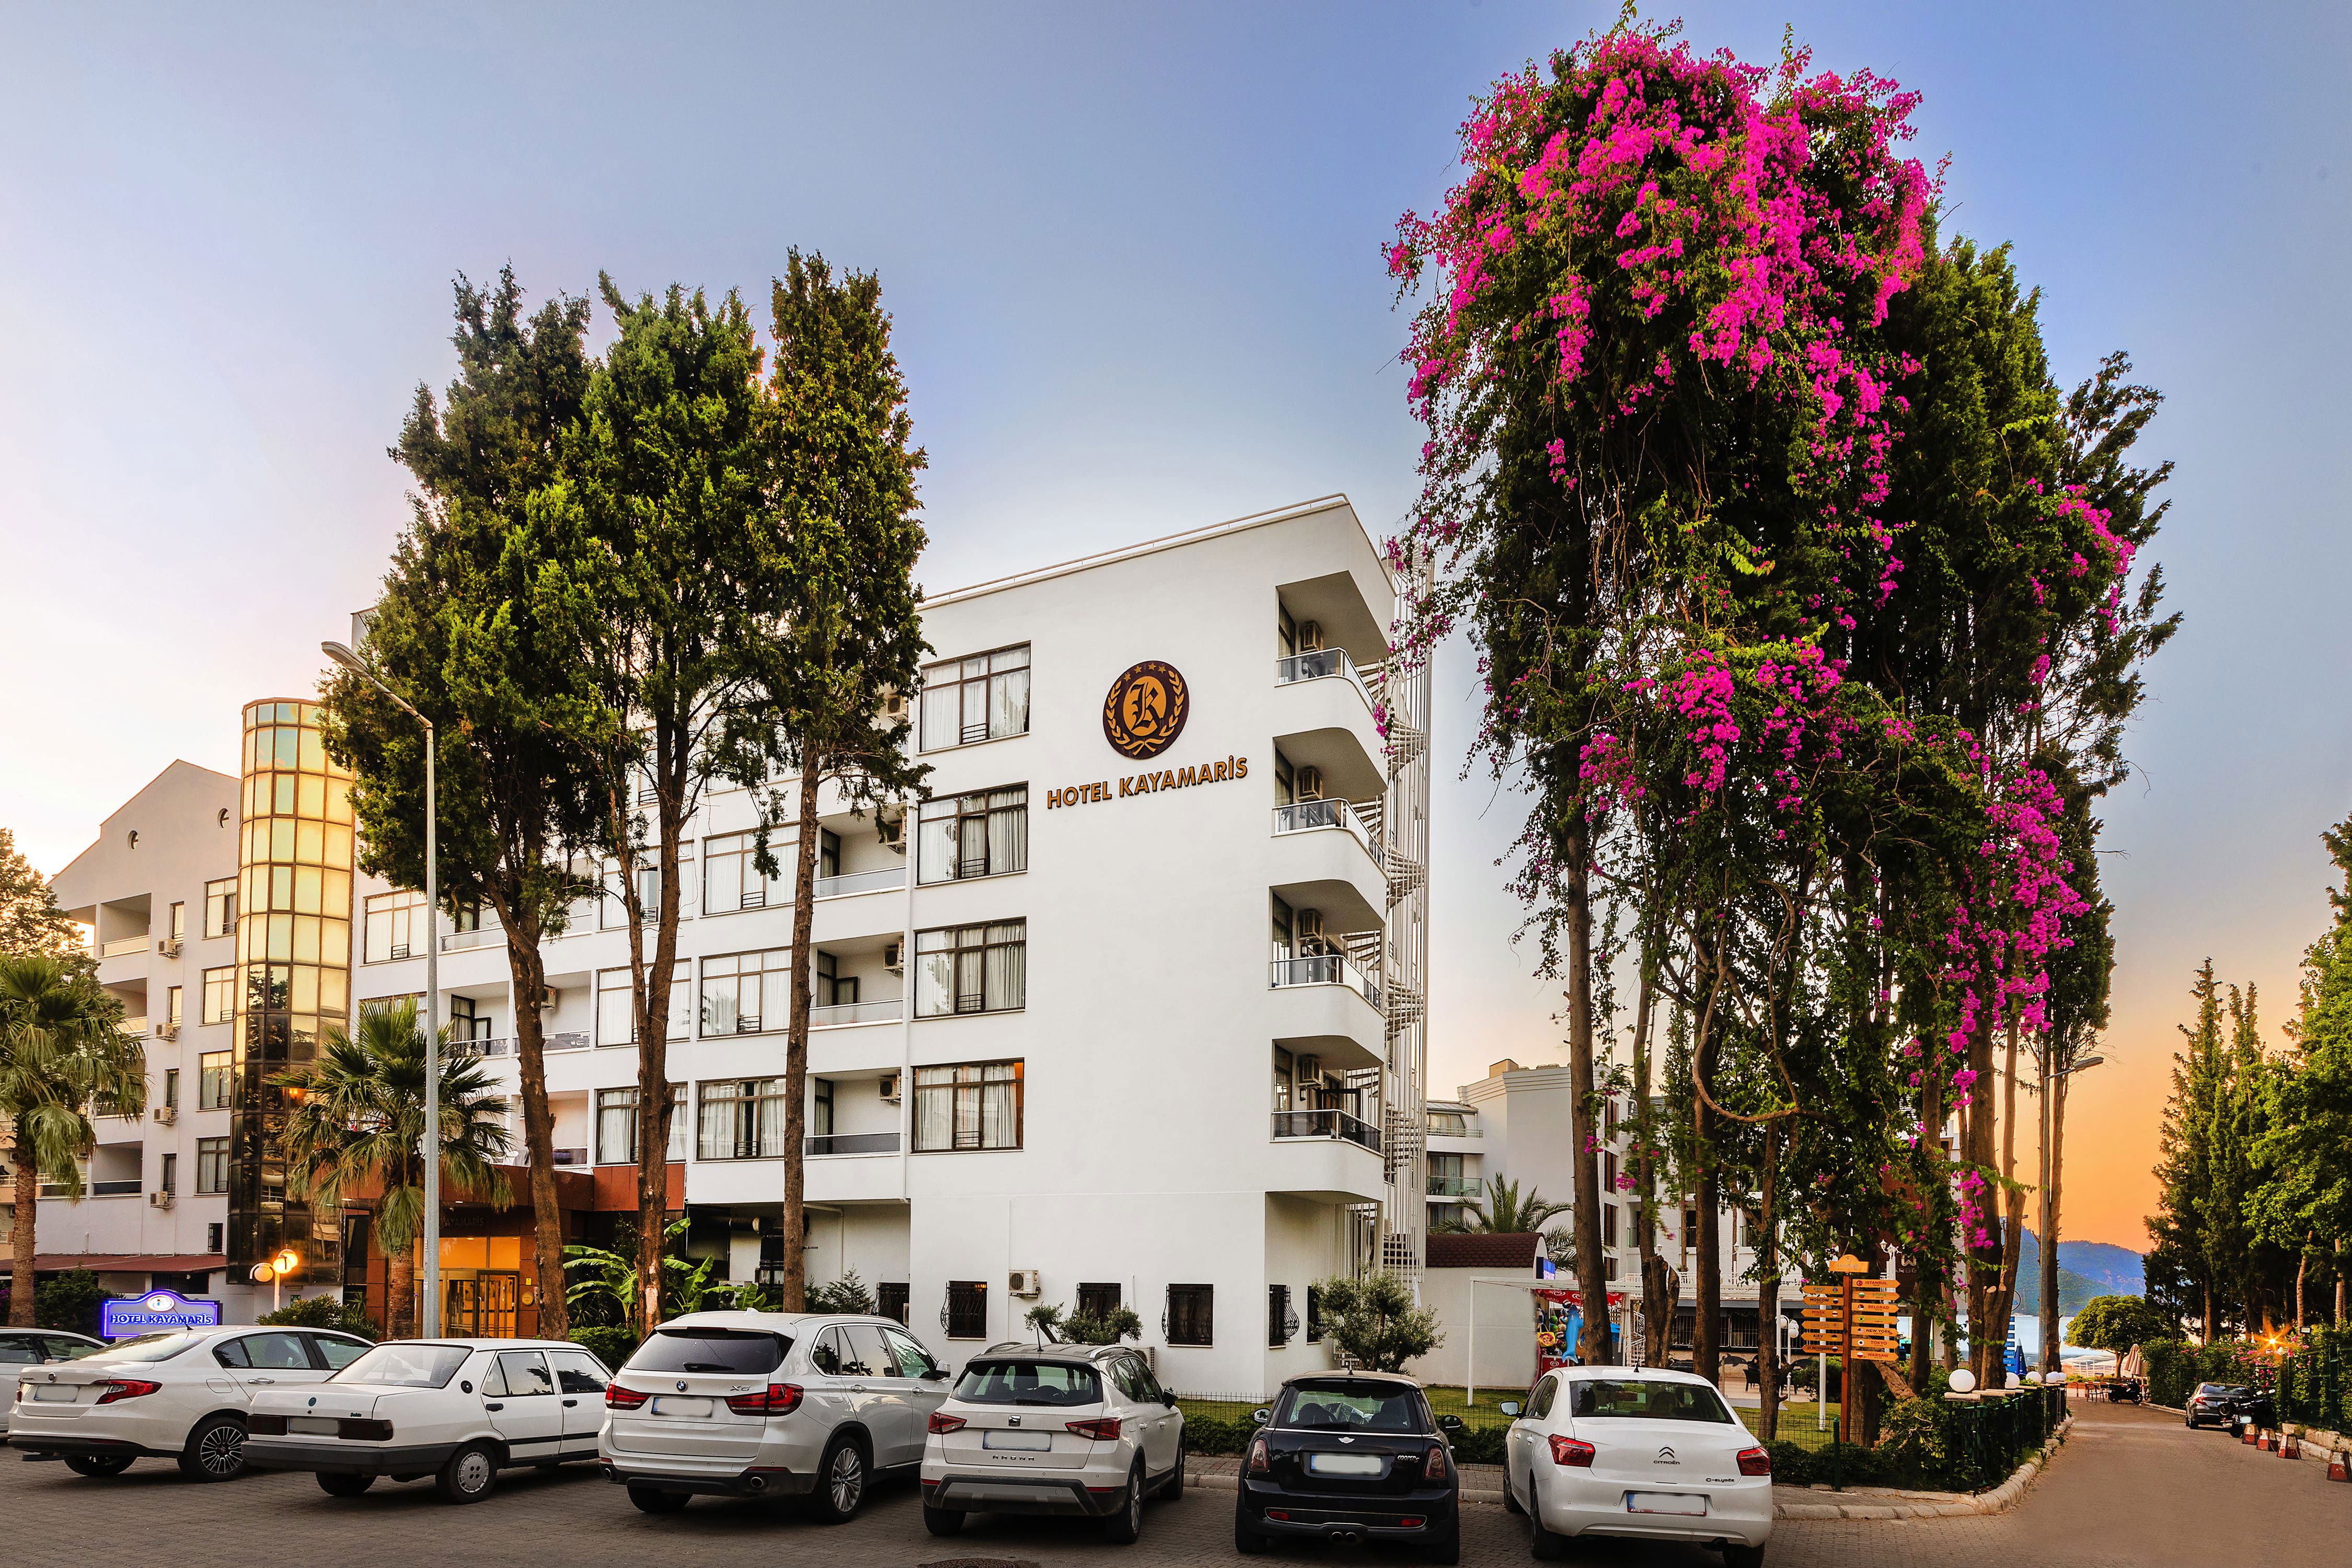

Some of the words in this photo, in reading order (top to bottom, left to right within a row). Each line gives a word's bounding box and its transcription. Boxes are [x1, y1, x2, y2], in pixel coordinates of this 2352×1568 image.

[1047, 781, 1112, 809] HOTEL
[1119, 755, 1248, 798] KAYAMARİS
[110, 1313, 147, 1324] HOTEL
[148, 1313, 214, 1325] KAYAMARİS
